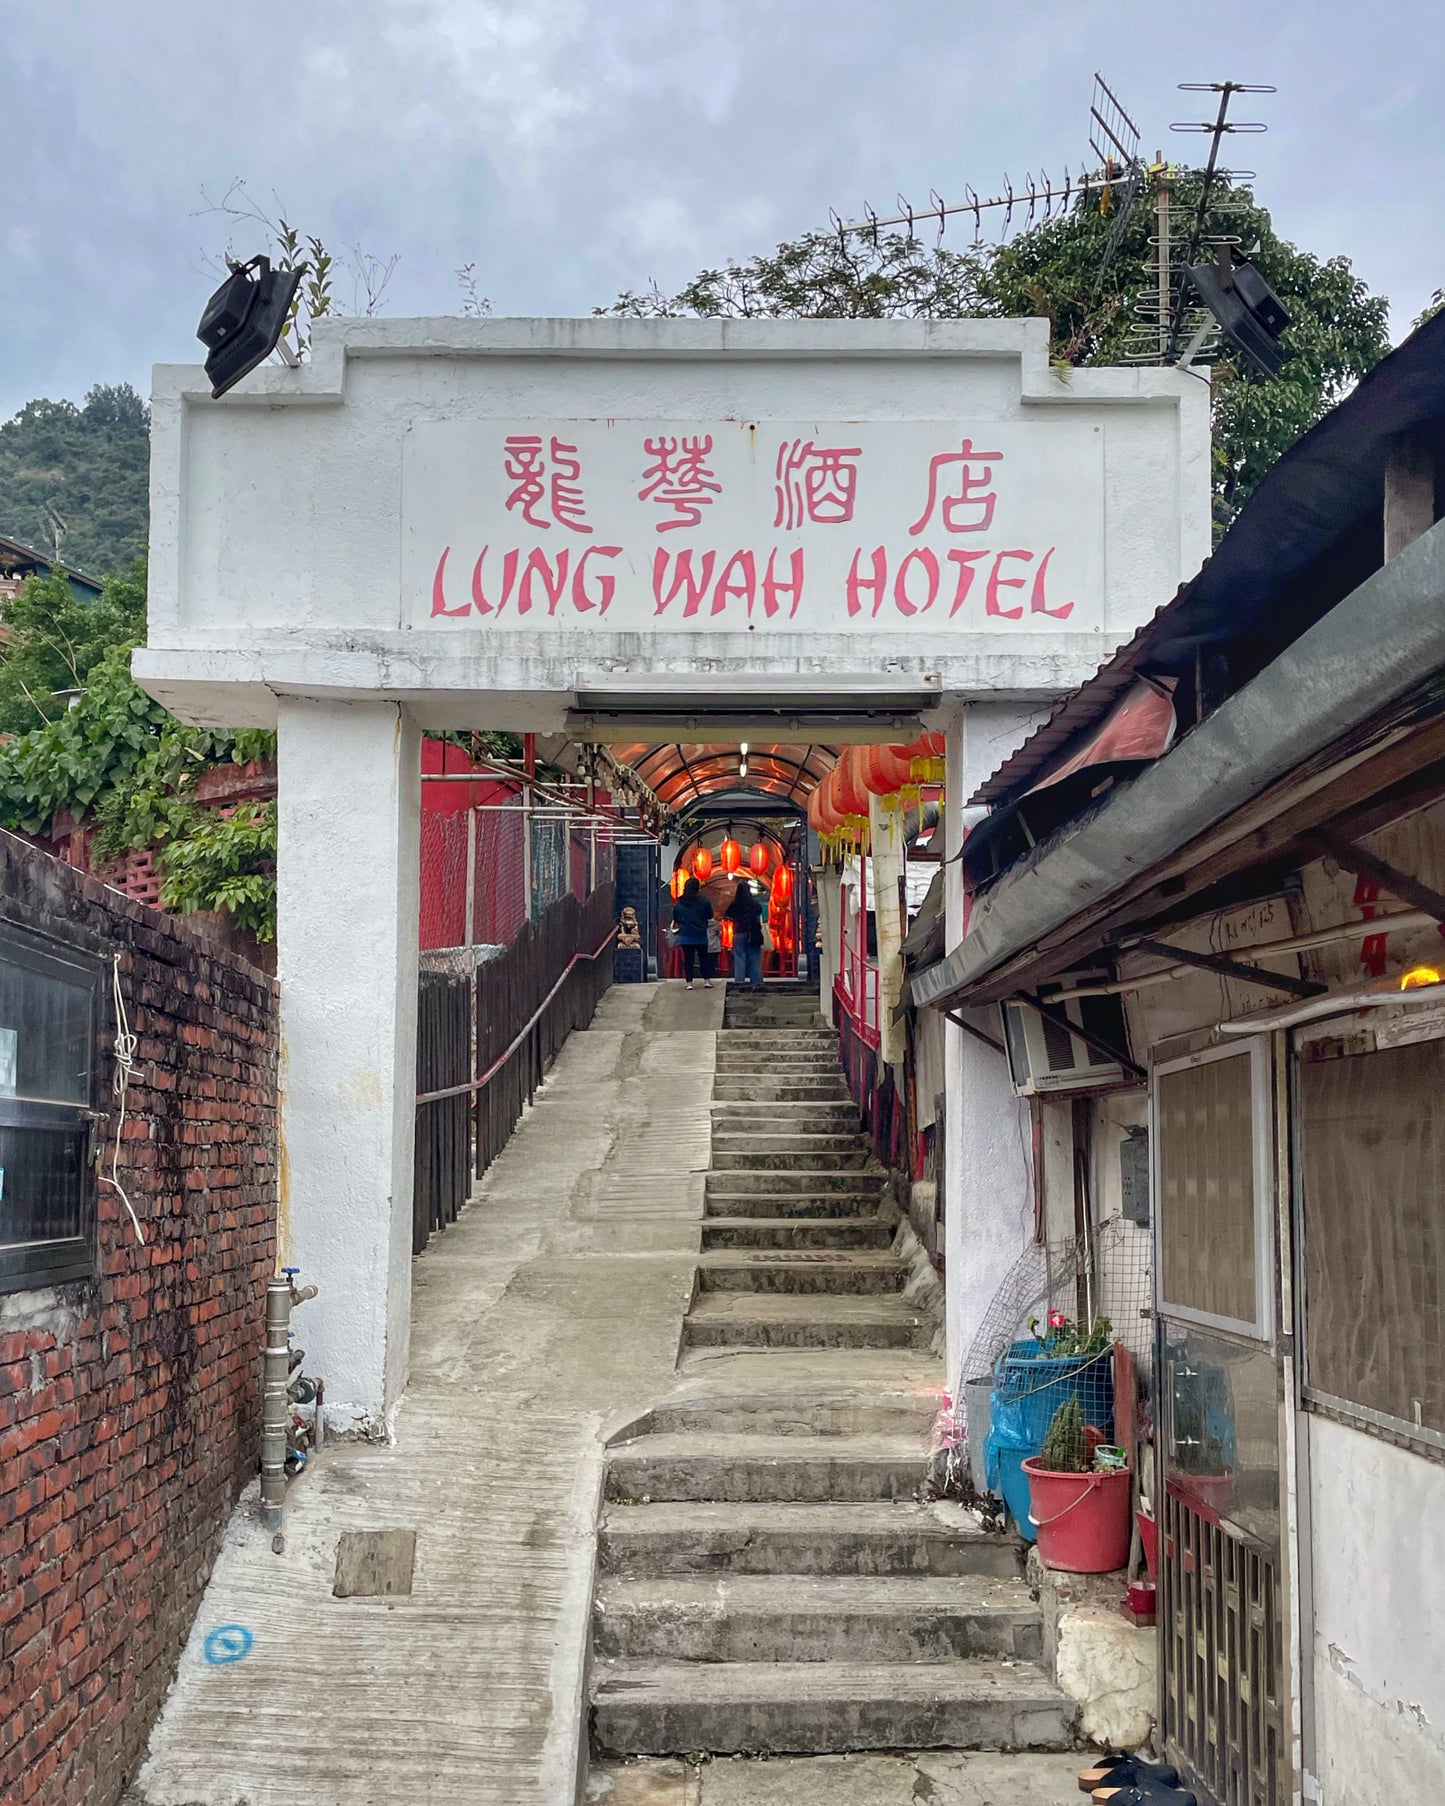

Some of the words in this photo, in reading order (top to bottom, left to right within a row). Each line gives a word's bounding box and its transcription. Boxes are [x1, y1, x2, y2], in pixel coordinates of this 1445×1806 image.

[431, 545, 622, 618] LUNG
[652, 546, 804, 619] WAH
[846, 545, 1074, 620] HOTEL
